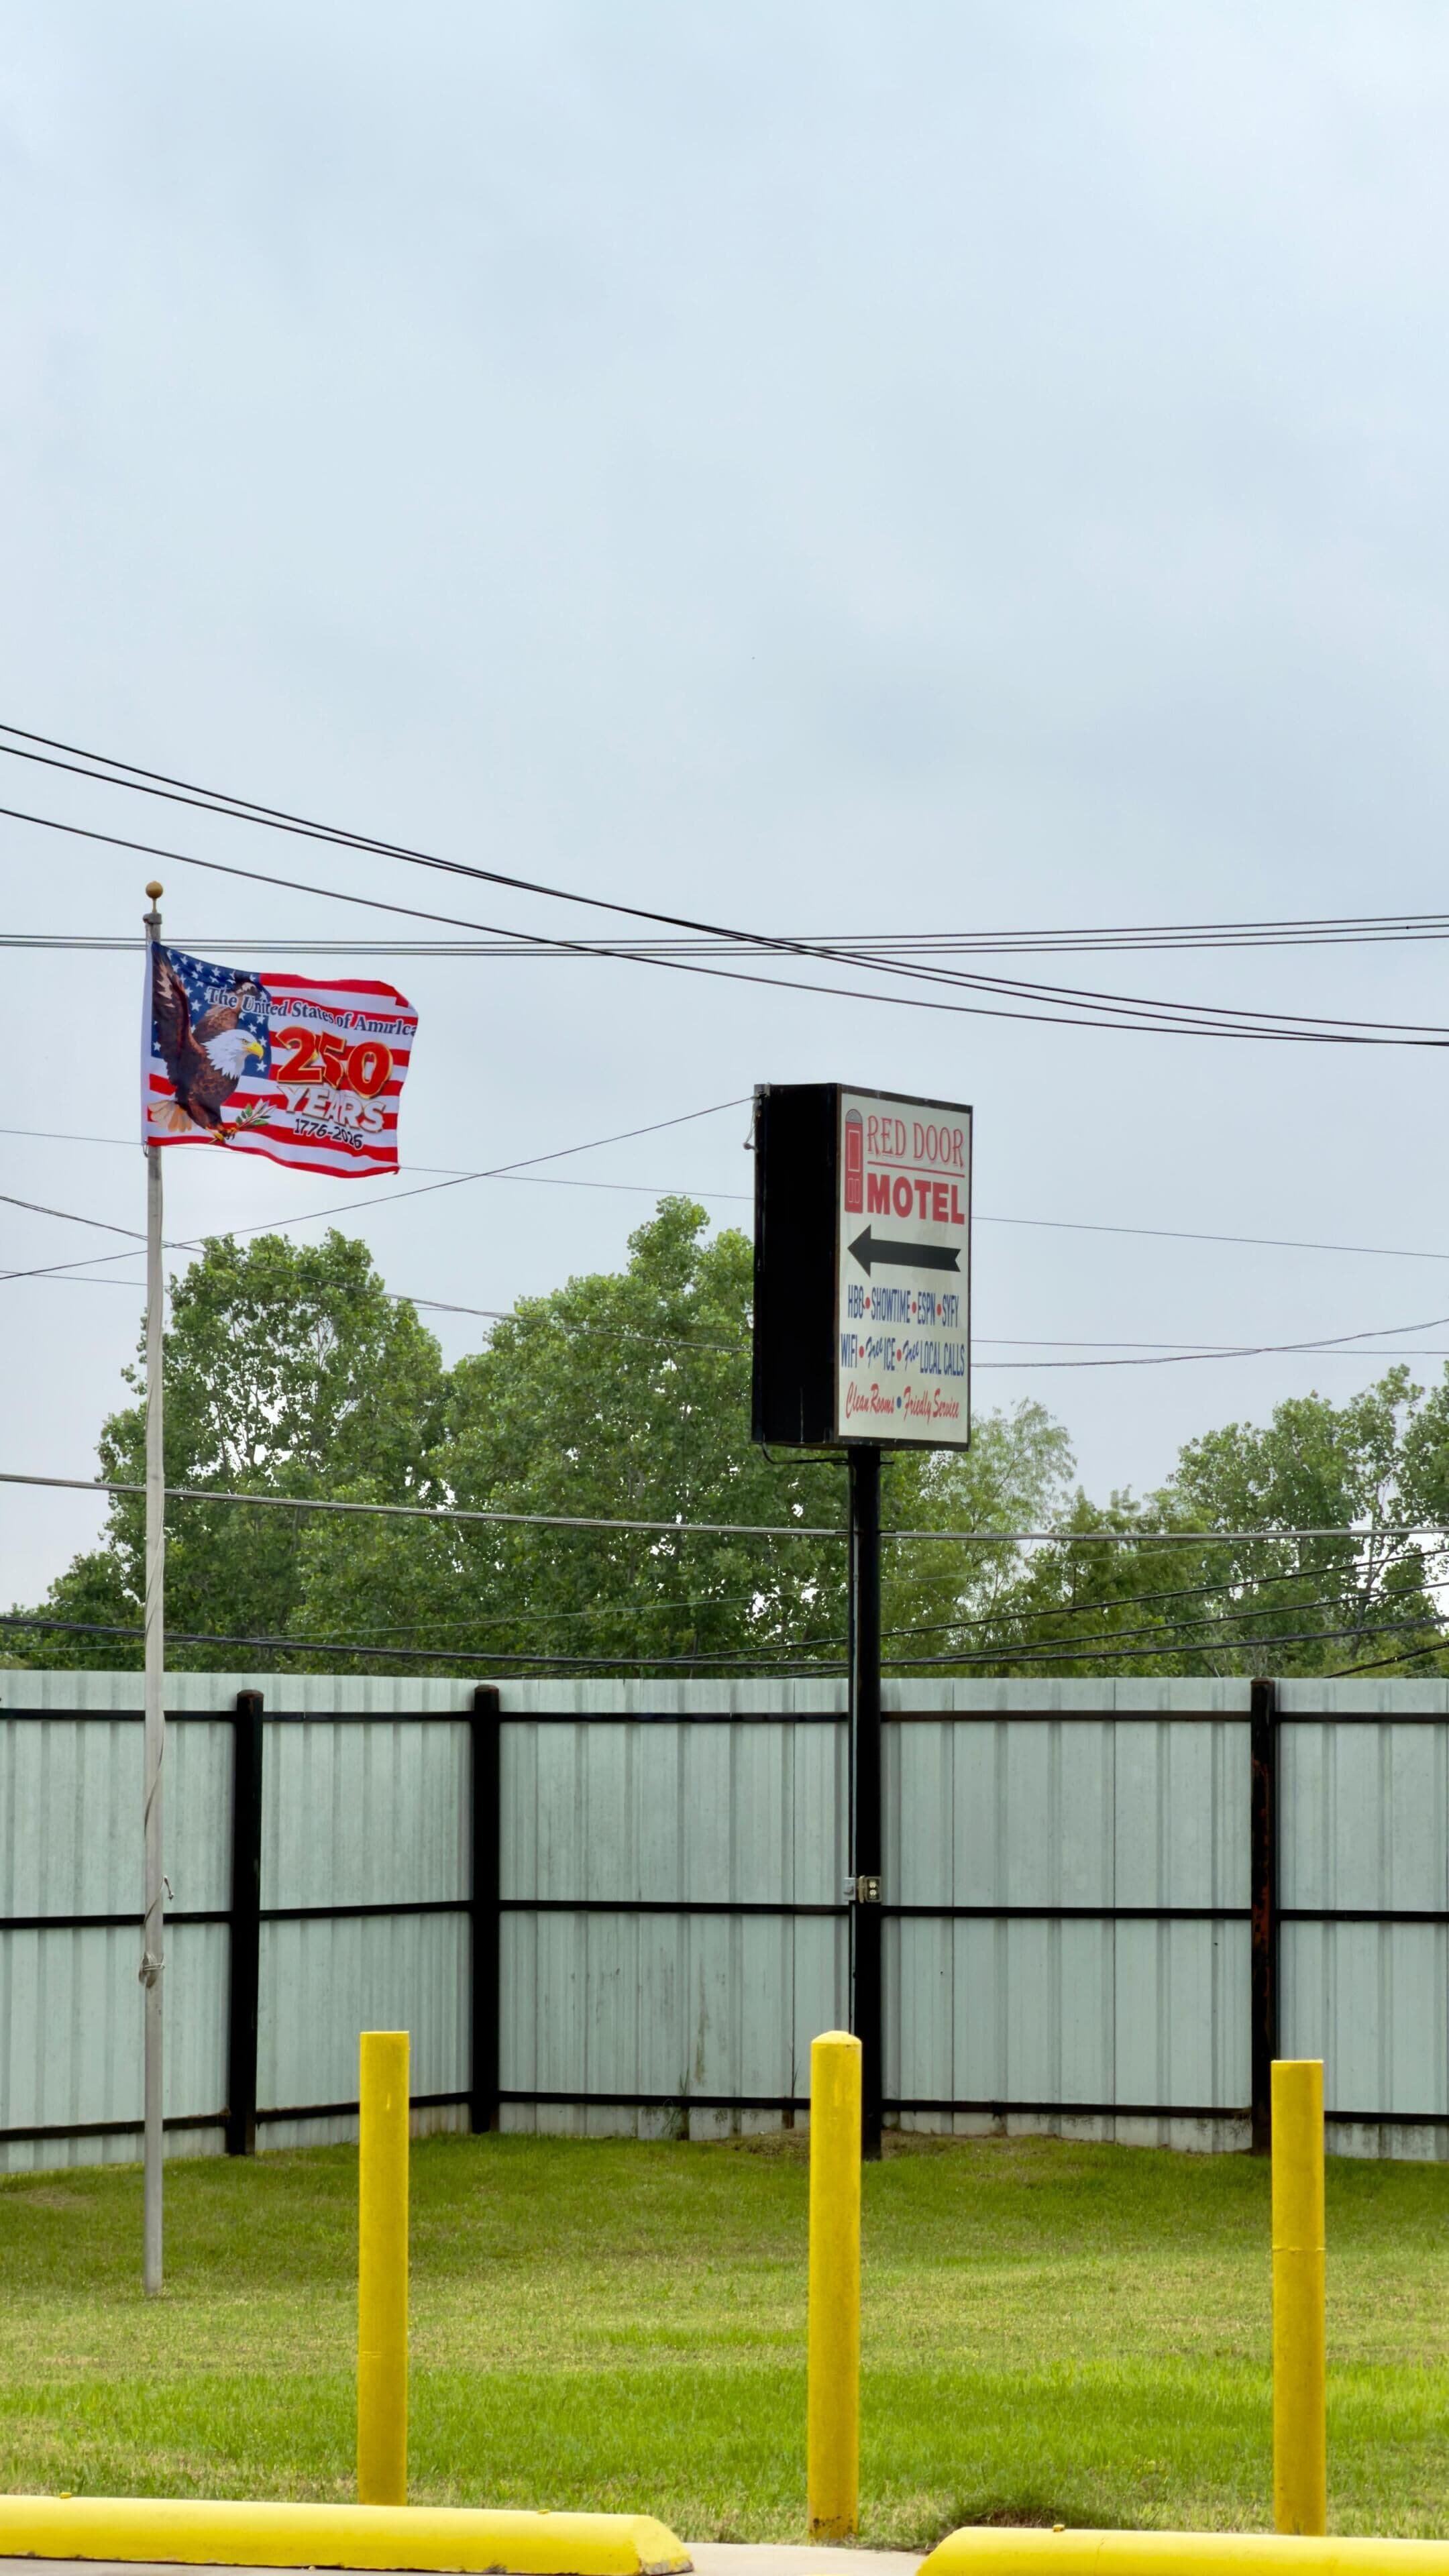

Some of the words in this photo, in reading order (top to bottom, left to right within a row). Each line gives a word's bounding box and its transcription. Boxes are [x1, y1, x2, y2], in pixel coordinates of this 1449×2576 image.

[207, 986, 237, 1008] The
[241, 994, 288, 1017] United
[291, 1002, 334, 1024] States
[337, 1013, 352, 1029] of
[276, 1026, 394, 1100] 250
[276, 1085, 386, 1134] YEARS
[294, 1118, 364, 1150] 1776-2026
[867, 1115, 906, 1158] RED
[913, 1122, 964, 1169] DOOR
[867, 1173, 965, 1225] MOTEL
[847, 1284, 864, 1320] HBO
[871, 1286, 911, 1324] SHOWTIME
[917, 1291, 936, 1326] ESPN
[942, 1293, 959, 1328] SYFY
[841, 1333, 858, 1368] WIFI
[865, 1336, 883, 1368] Free
[883, 1337, 896, 1371] ICE
[902, 1340, 919, 1372] Free
[920, 1340, 942, 1375] LOCAL
[943, 1342, 965, 1376] CALLS
[845, 1381, 869, 1419] Clean
[869, 1383, 894, 1415] Rooms
[933, 1388, 959, 1419] Service
